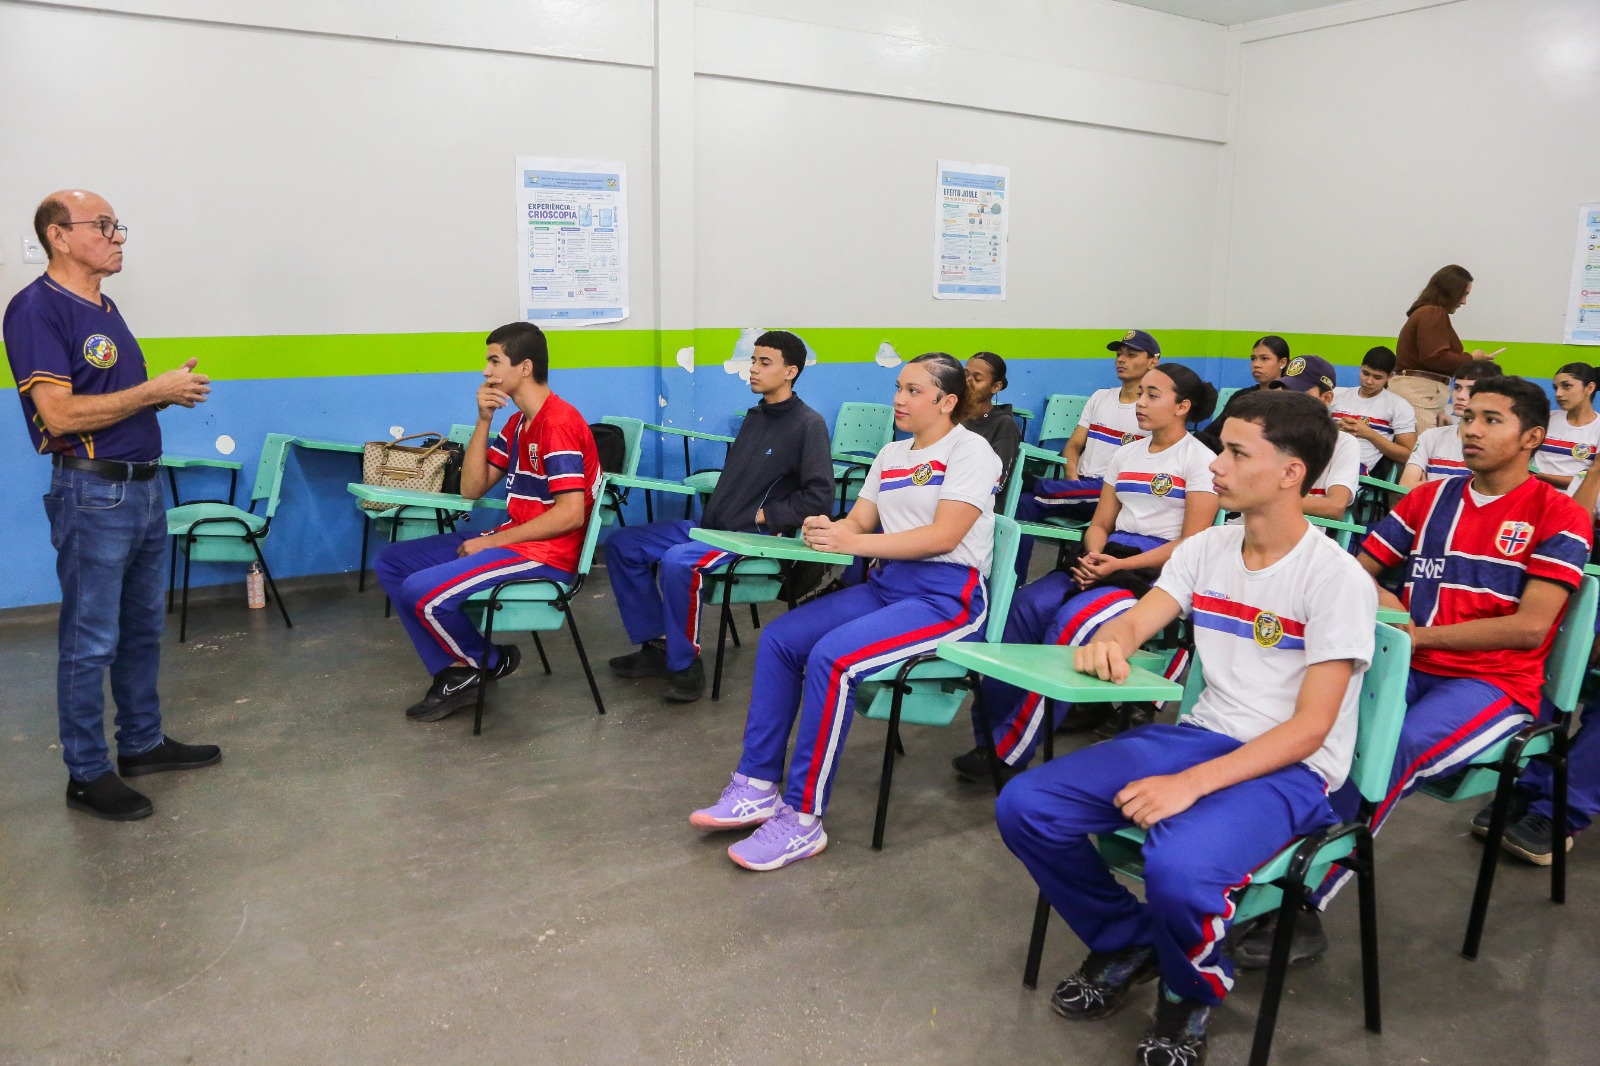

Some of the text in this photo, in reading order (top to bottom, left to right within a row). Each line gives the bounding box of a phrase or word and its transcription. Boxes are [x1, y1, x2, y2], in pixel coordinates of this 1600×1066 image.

[943, 188, 978, 199] EFEITO JOULE
[528, 210, 578, 220] CRIOSCOPIA
